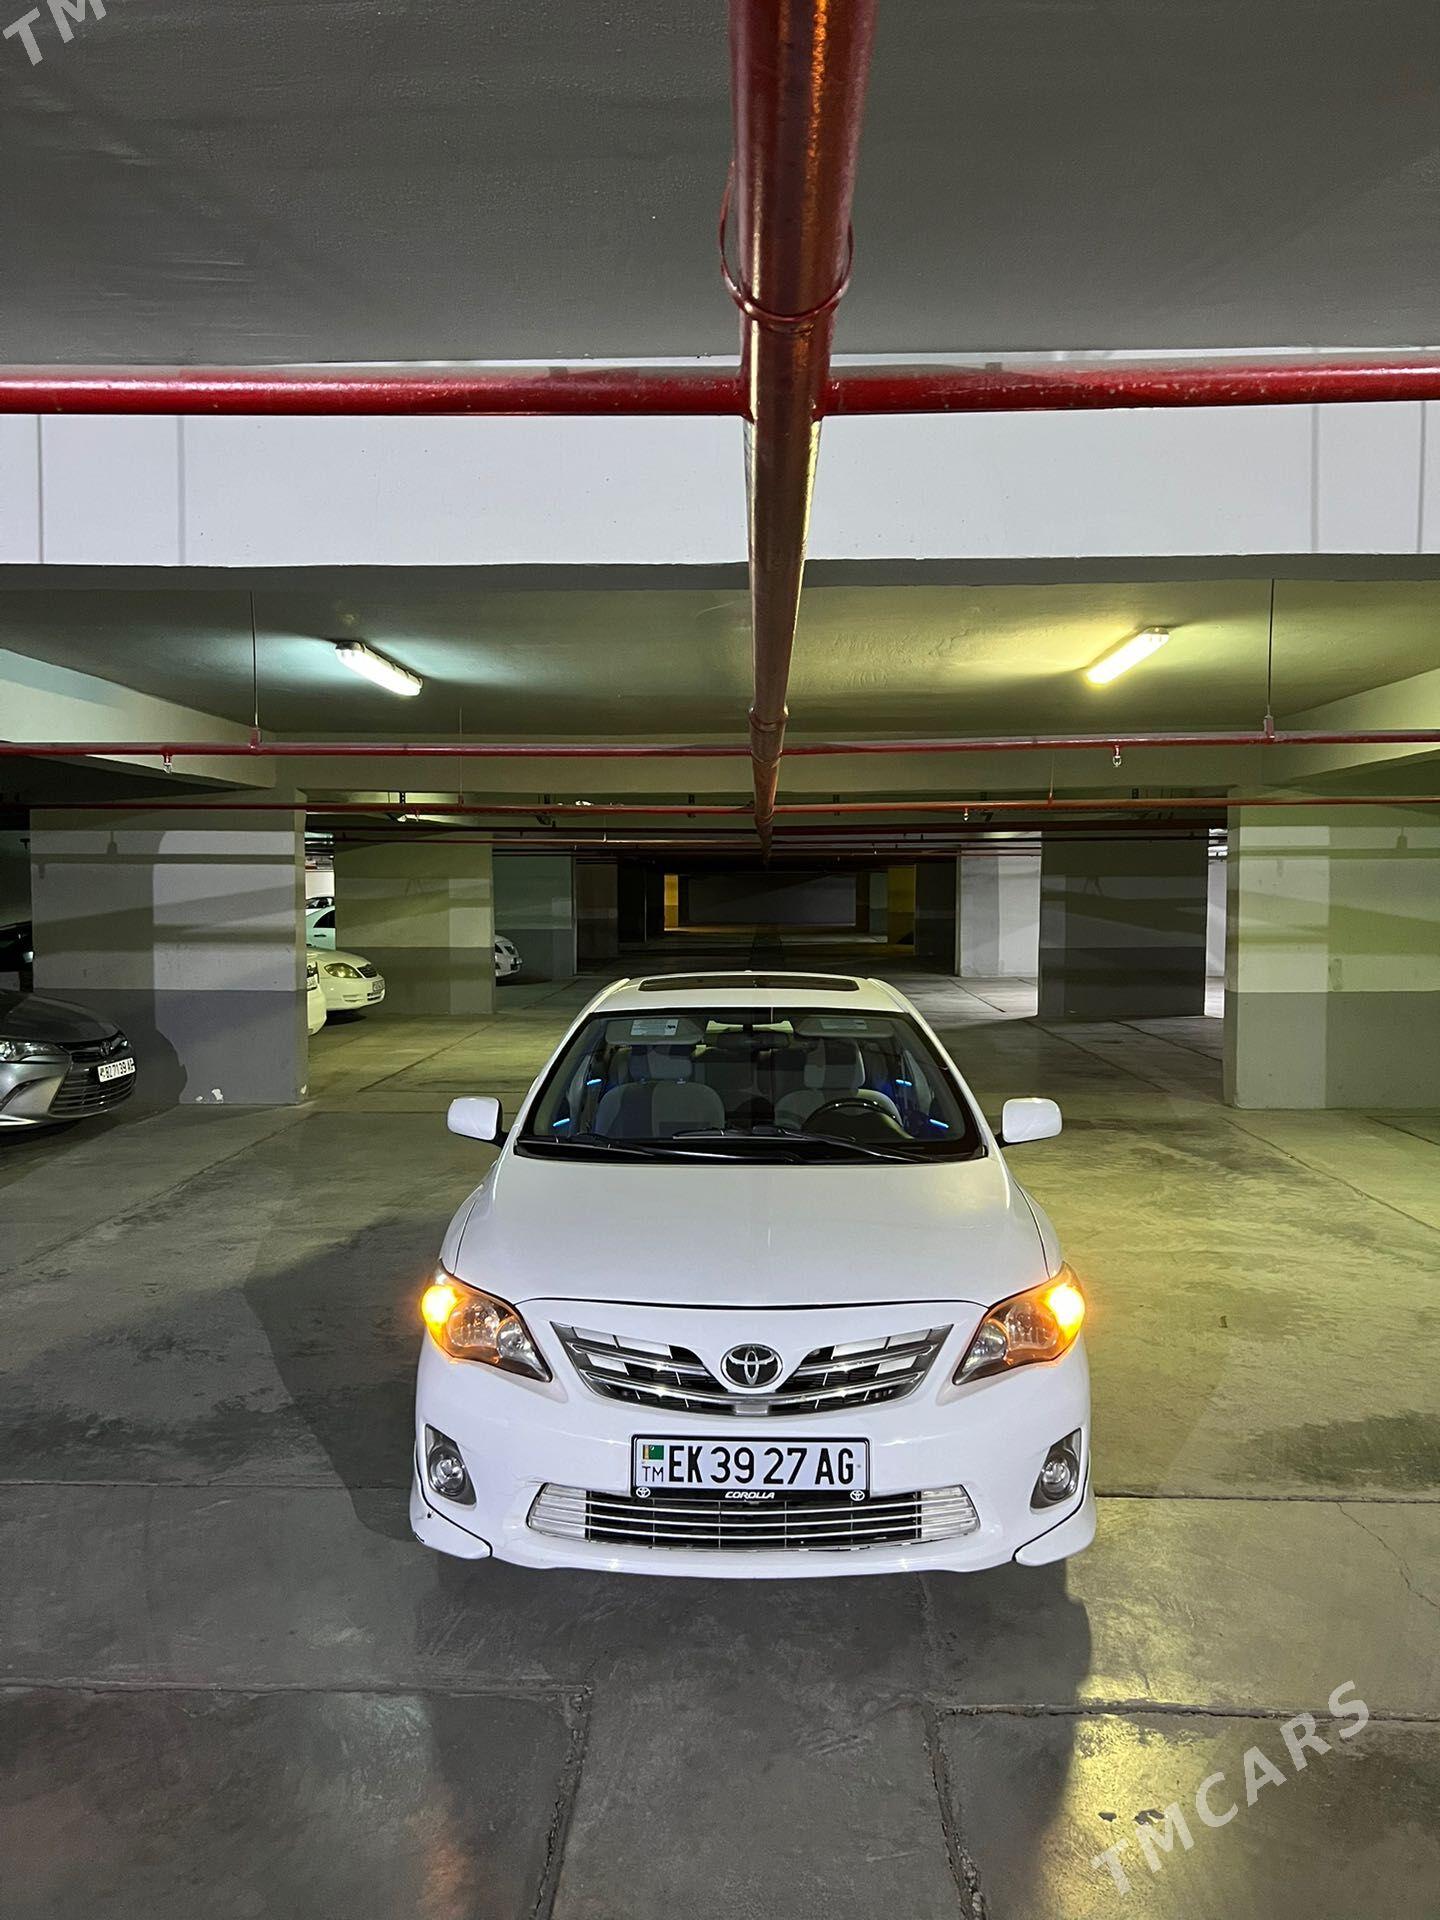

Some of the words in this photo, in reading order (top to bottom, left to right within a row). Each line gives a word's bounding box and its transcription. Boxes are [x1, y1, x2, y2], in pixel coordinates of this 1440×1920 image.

[642, 1465, 664, 1482] TM
[668, 1445, 703, 1483] EK
[710, 1446, 755, 1484] 39
[763, 1447, 808, 1485] 27
[814, 1447, 854, 1485] AG
[724, 1490, 775, 1500] COROLLA
